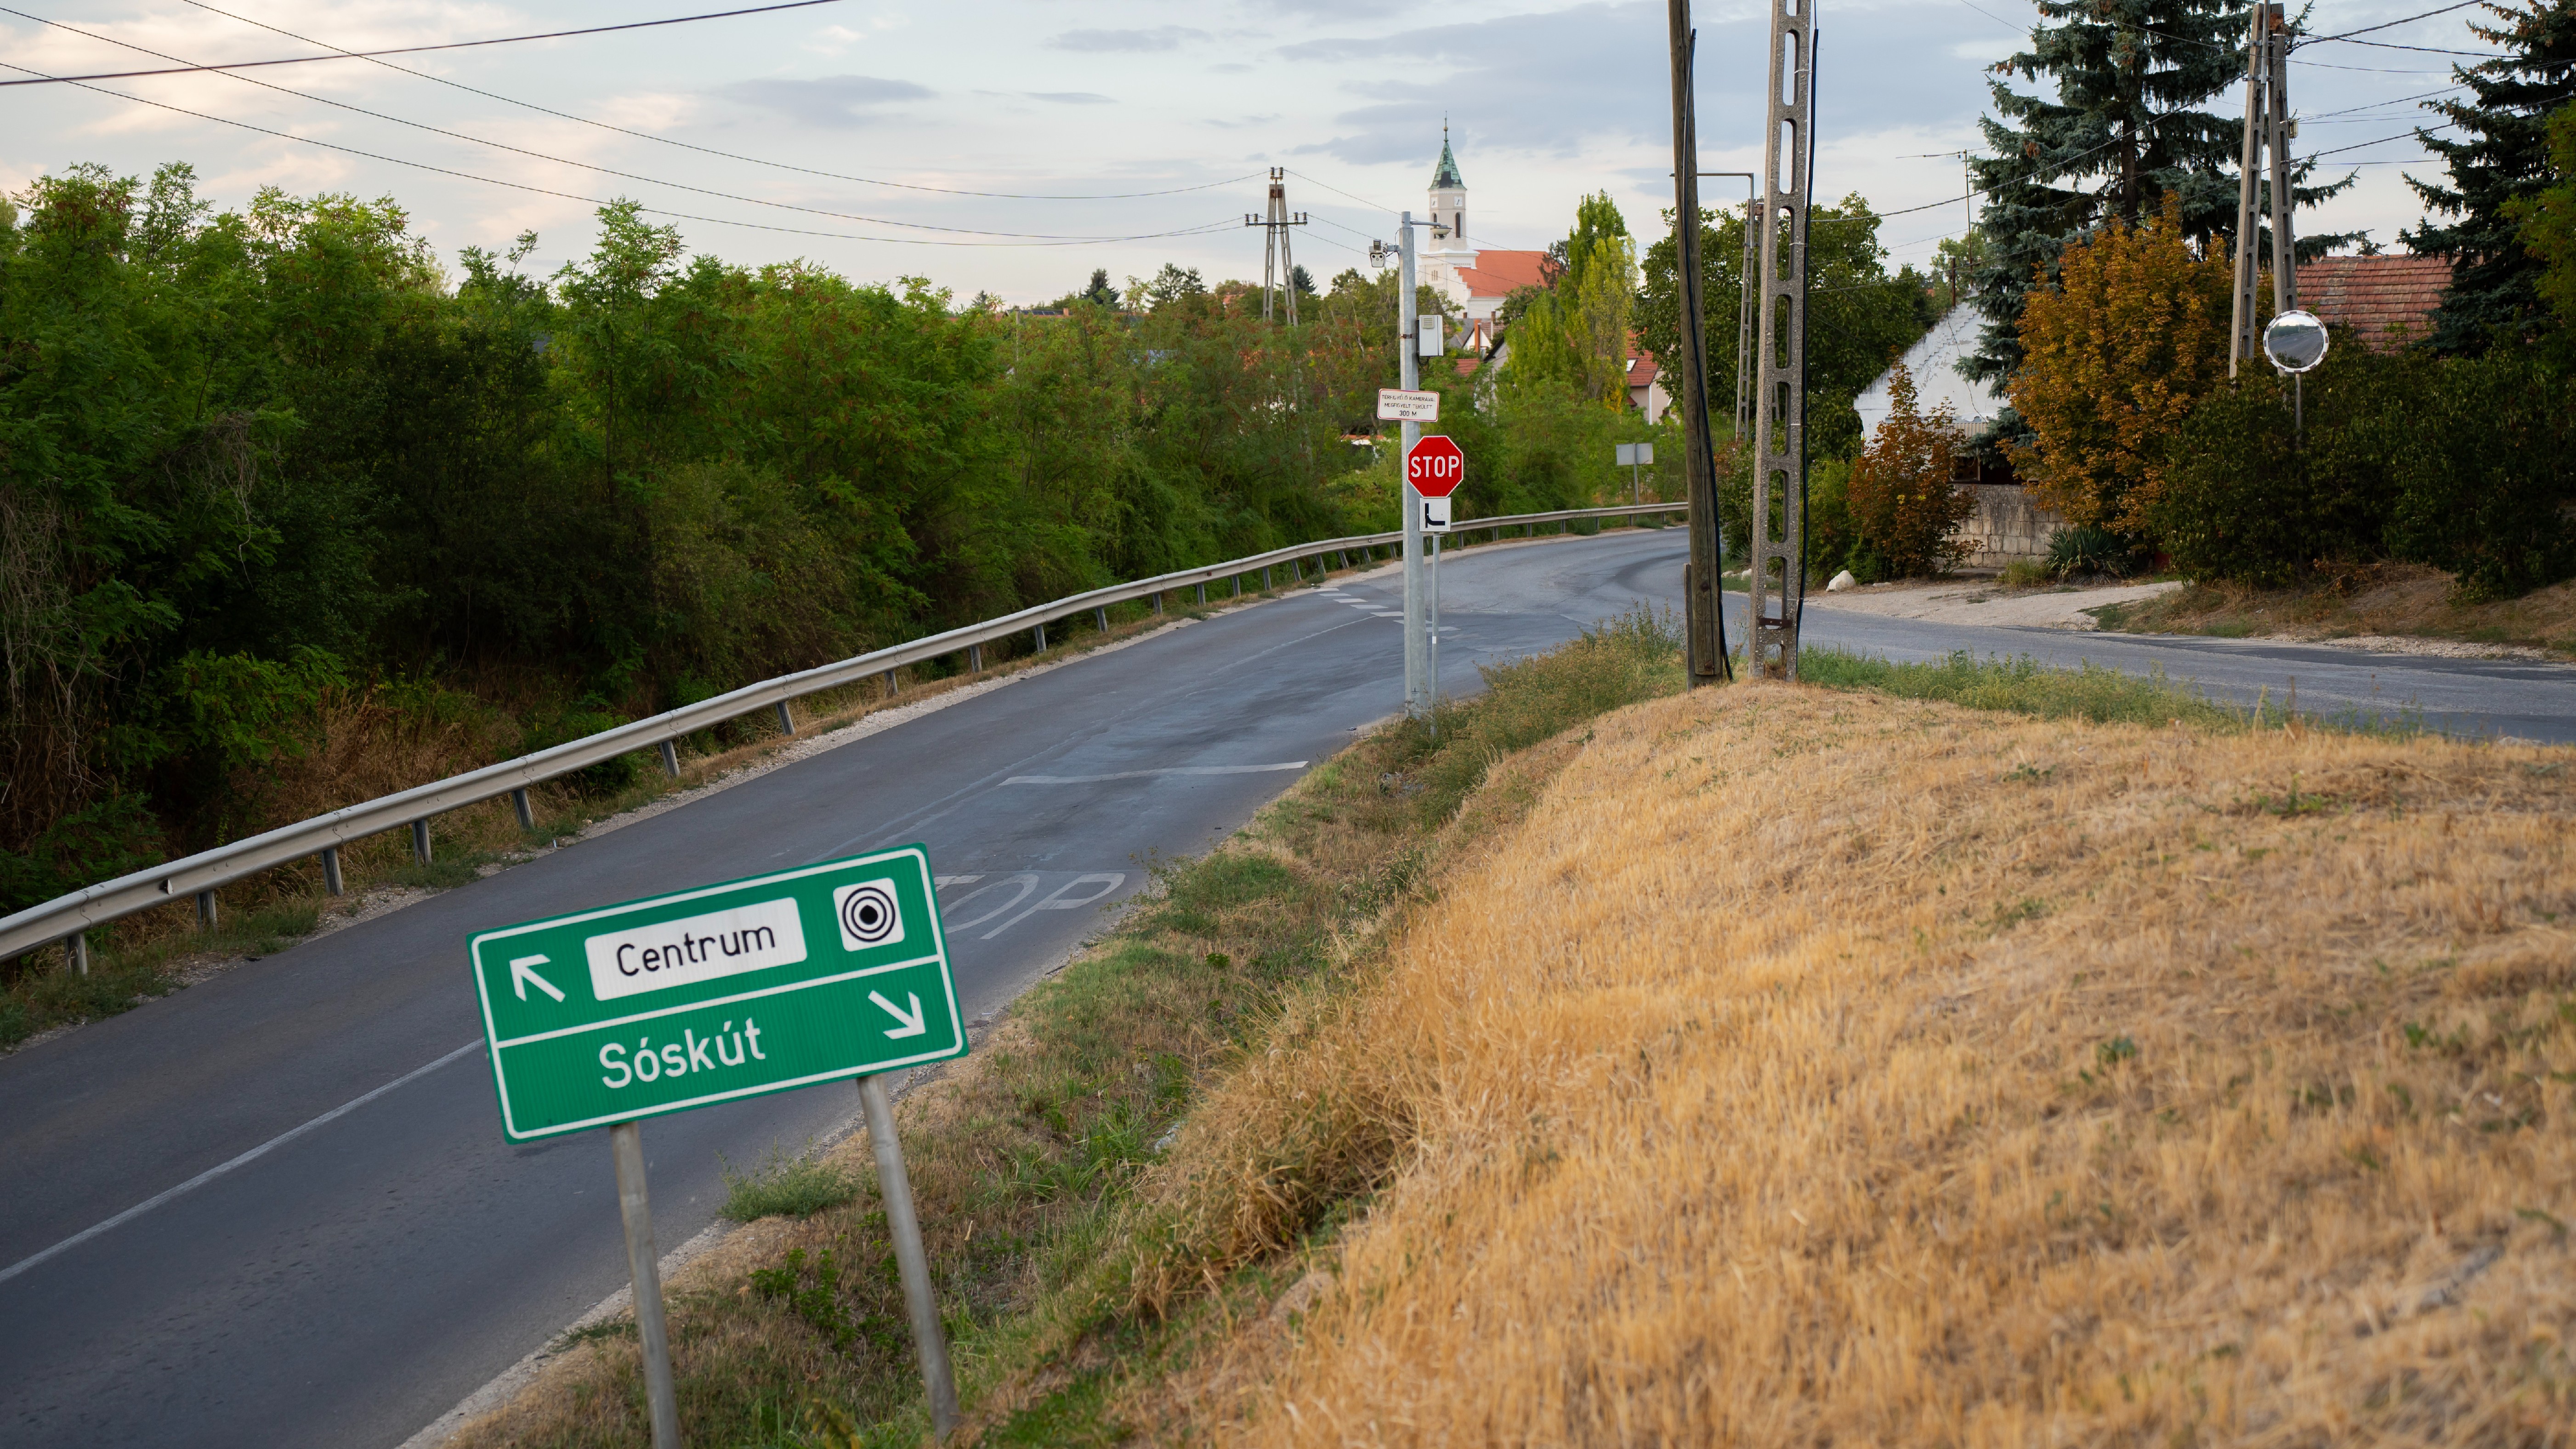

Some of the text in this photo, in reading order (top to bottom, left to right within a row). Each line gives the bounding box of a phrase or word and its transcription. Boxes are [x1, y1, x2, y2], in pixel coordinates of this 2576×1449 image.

[1411, 456, 1460, 477] STOP
[616, 926, 776, 977] Centrum
[599, 1017, 766, 1089] Sóskút
